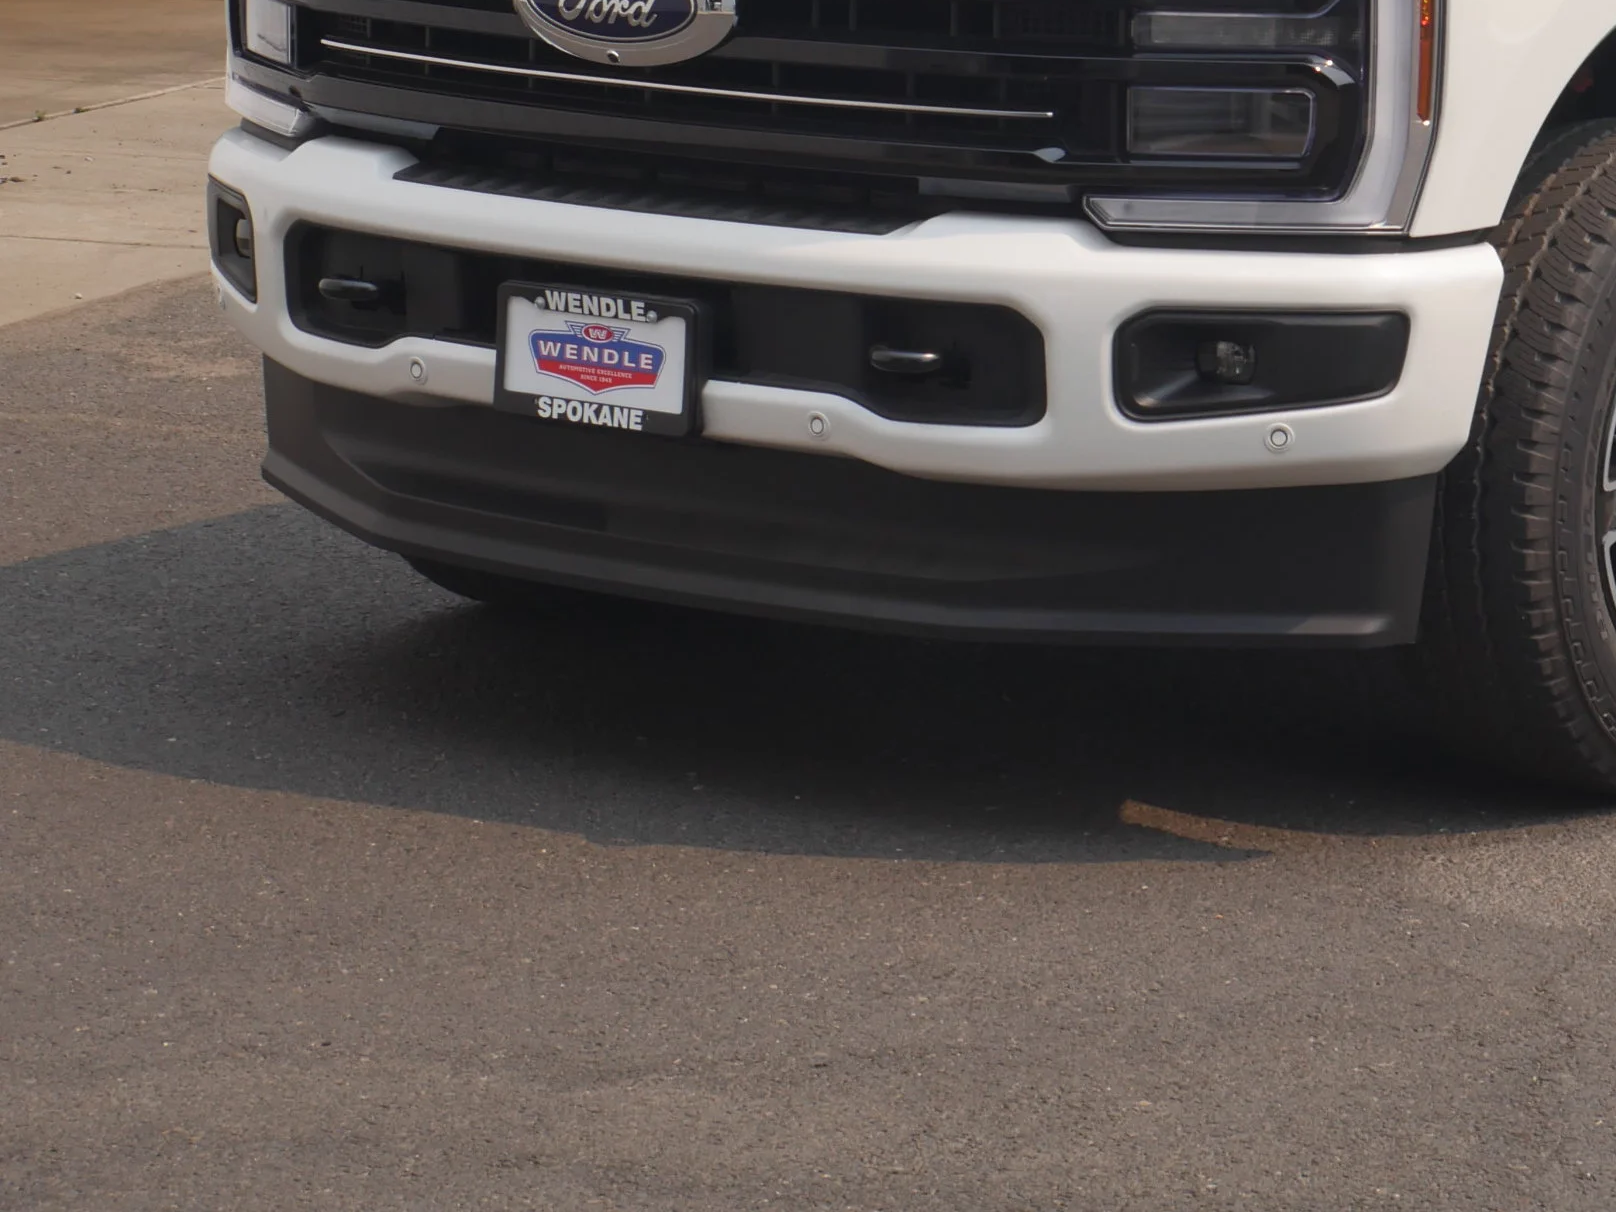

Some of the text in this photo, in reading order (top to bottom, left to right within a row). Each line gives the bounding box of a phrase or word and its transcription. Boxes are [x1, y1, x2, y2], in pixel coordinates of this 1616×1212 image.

[545, 290, 647, 322] WENDLE
[588, 328, 608, 340] W
[538, 340, 653, 370] WENDLE
[558, 364, 632, 379] AUTOMOTIVE EXCELLENCE
[580, 374, 597, 383] SINCE
[537, 396, 643, 431] SPOKANE
